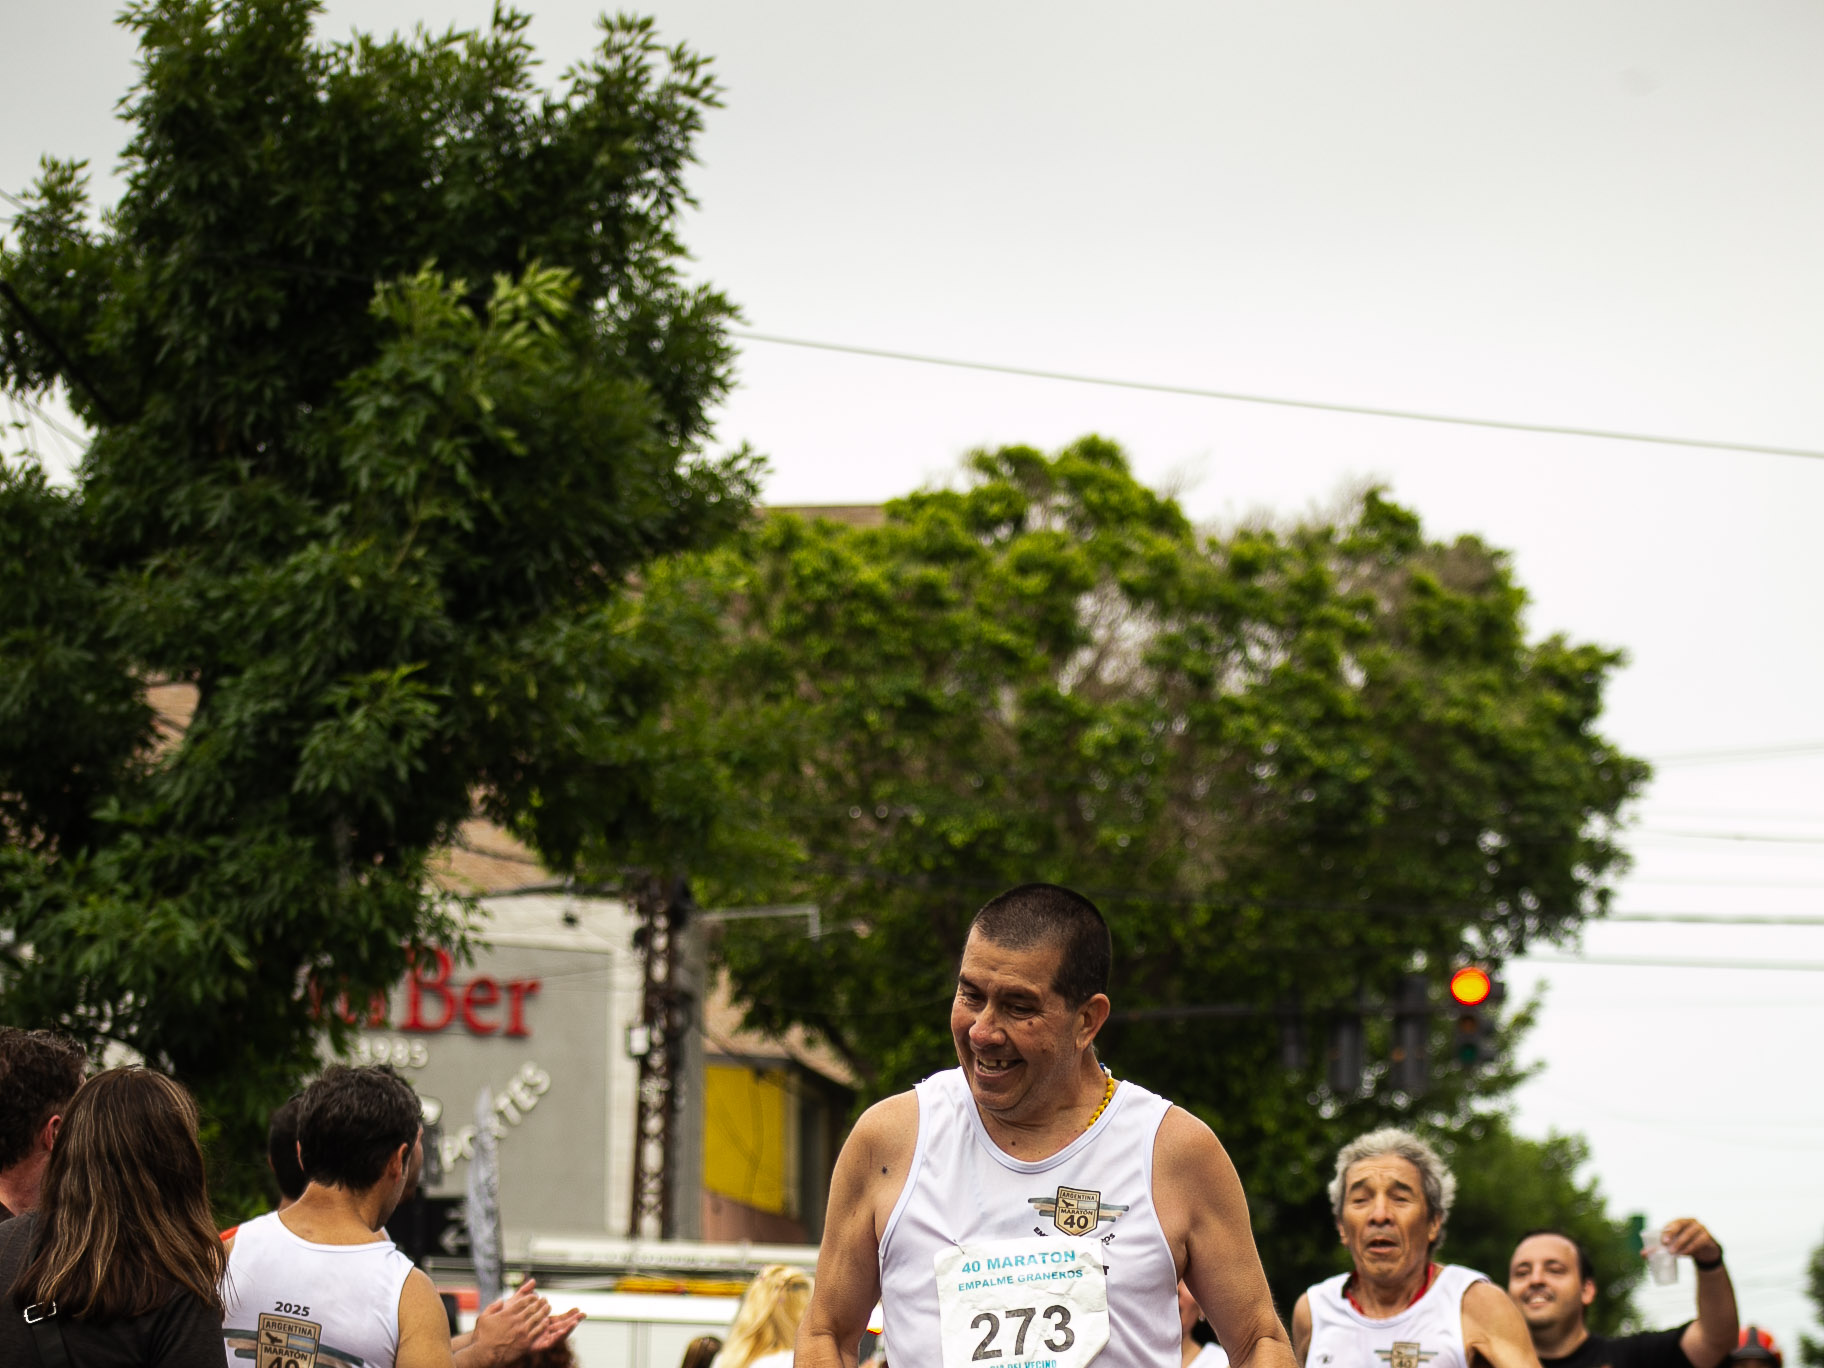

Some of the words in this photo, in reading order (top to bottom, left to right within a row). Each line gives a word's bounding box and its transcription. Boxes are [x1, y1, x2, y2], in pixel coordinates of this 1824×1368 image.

[1062, 1191, 1095, 1201] ARGENTINA
[1063, 1215, 1089, 1229] 40
[961, 1261, 981, 1273] 40
[987, 1250, 1076, 1270] MARATON
[958, 1276, 1014, 1291] EMPALME
[1017, 1269, 1083, 1283] GRANEROS
[274, 1301, 310, 1316] 2025
[265, 1321, 312, 1337] ARGENTINA
[970, 1304, 1075, 1362] 273
